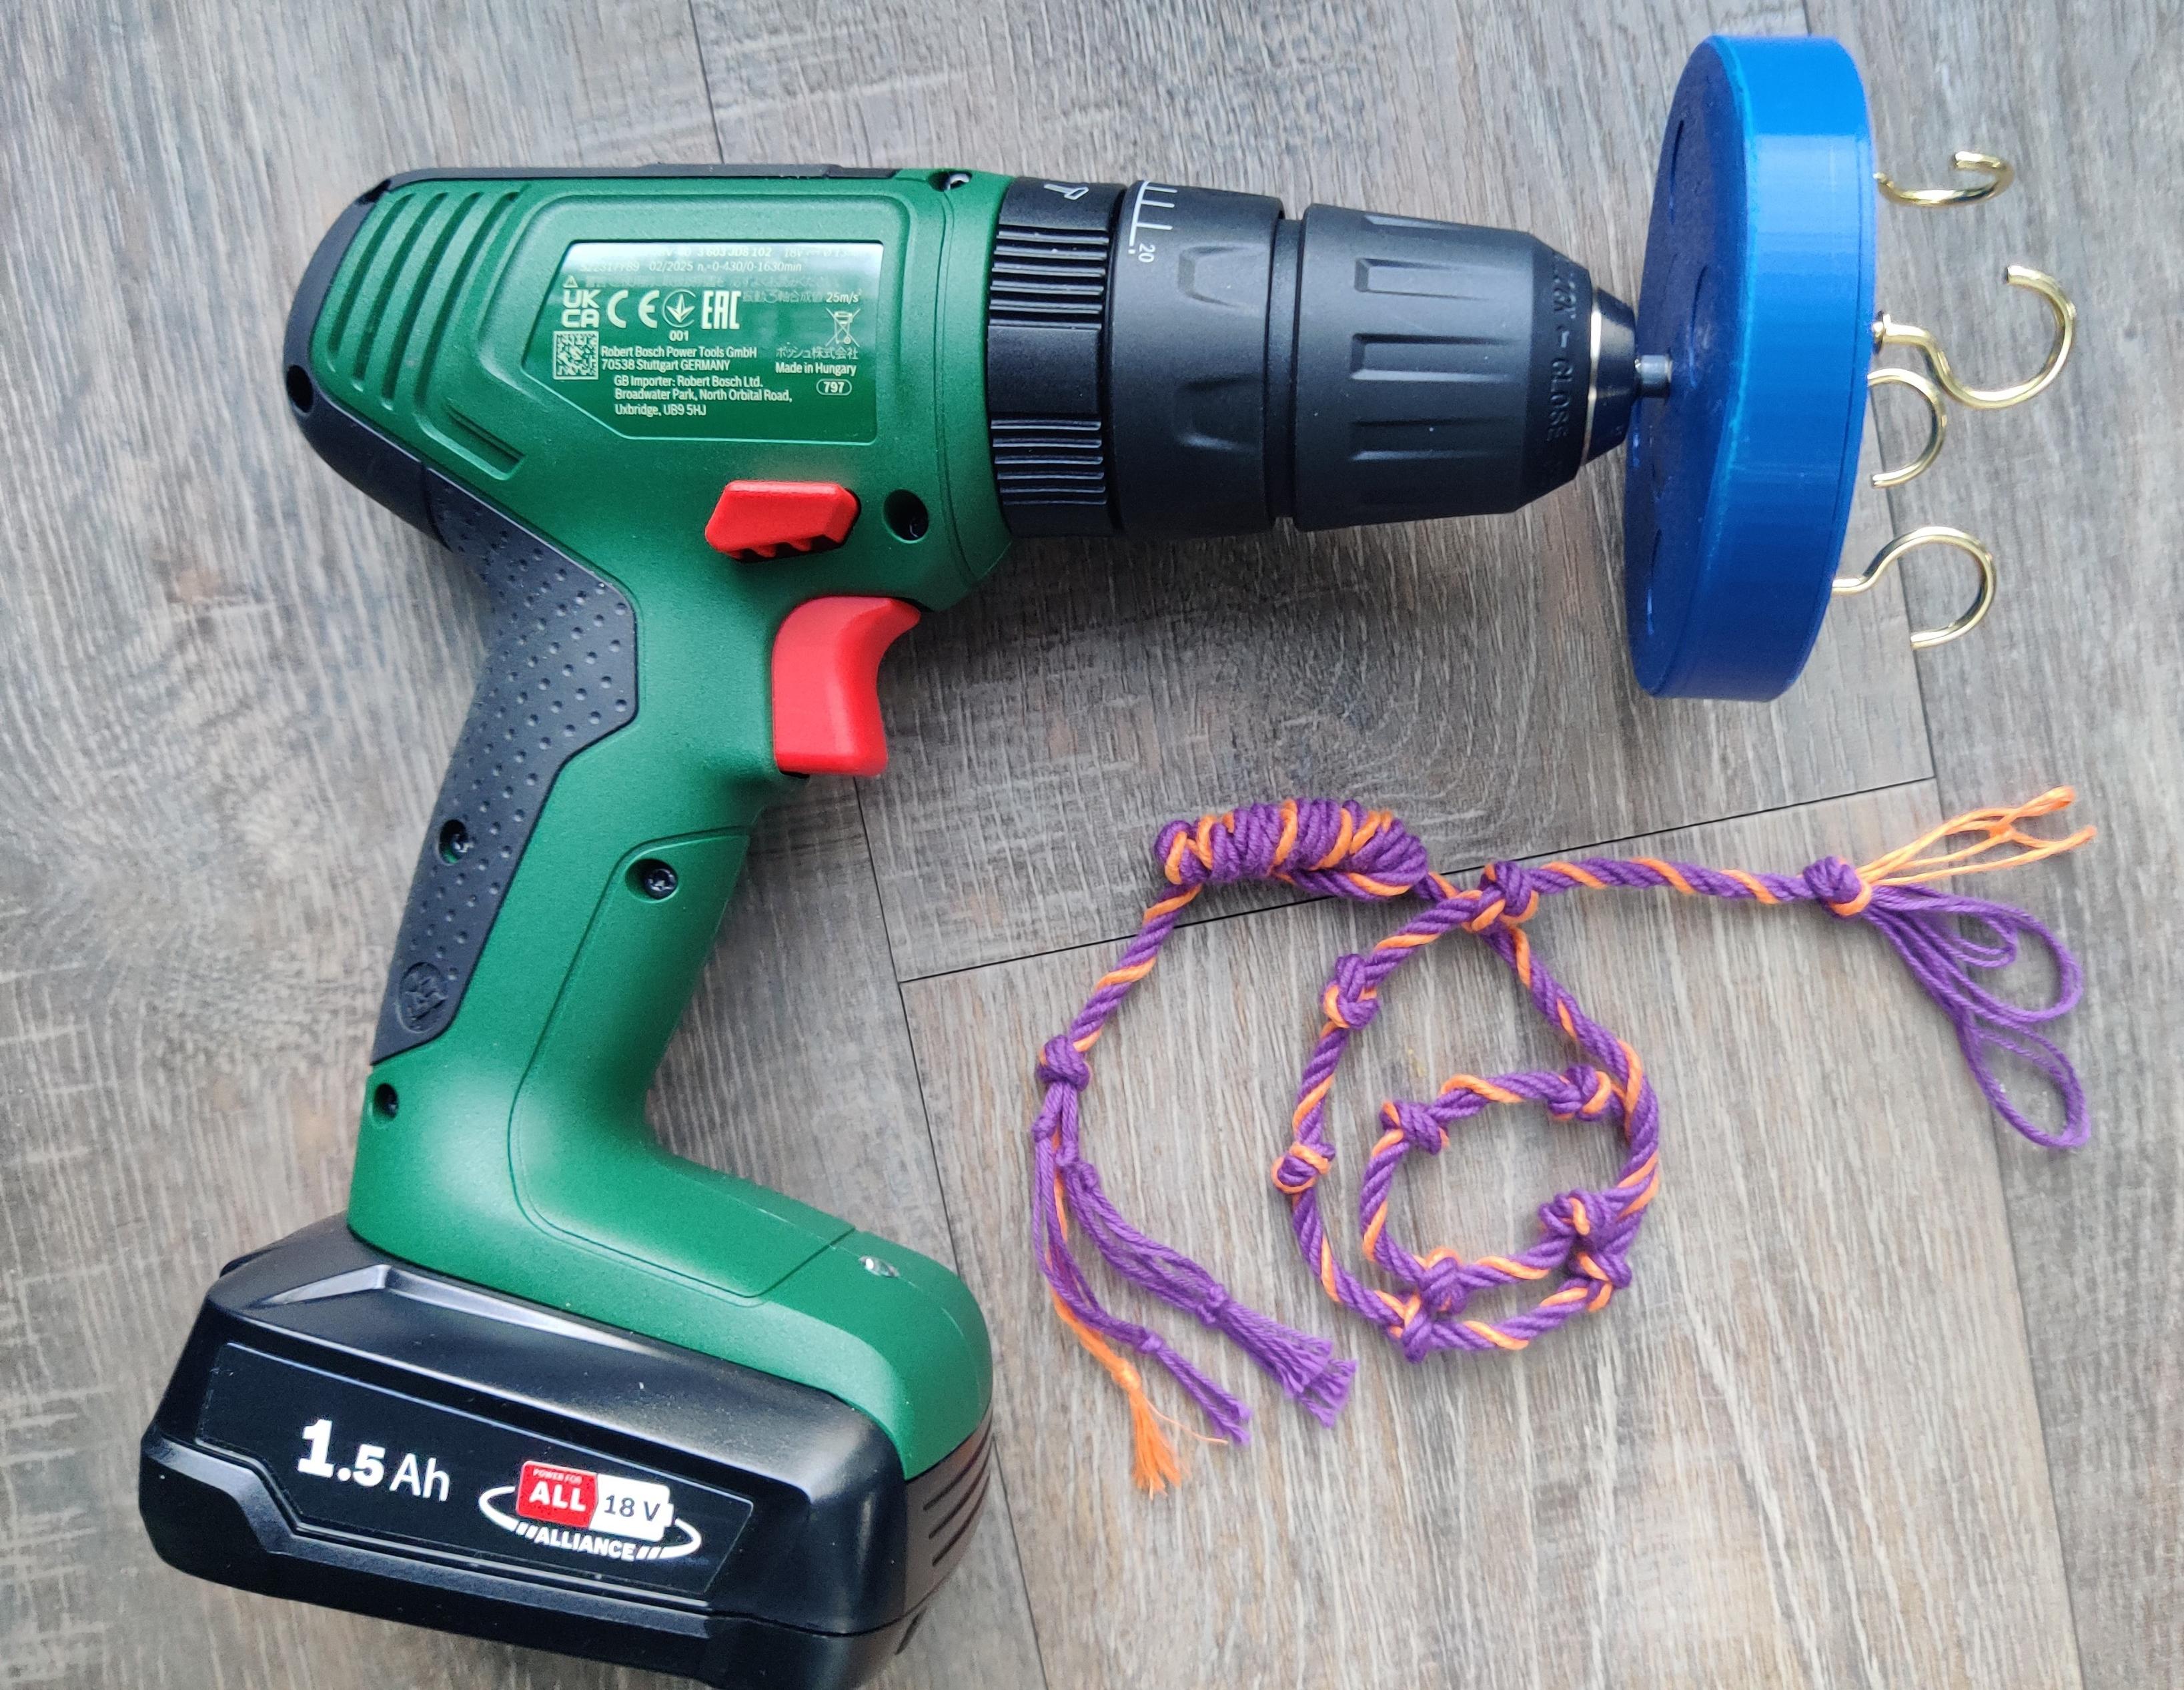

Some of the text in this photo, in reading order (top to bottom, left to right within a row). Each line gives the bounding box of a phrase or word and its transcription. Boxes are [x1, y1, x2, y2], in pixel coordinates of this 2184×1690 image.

[752, 247, 772, 258] 102
[1138, 243, 1156, 263] 20
[649, 261, 693, 273] 02/2025
[562, 290, 600, 308] UK
[607, 289, 660, 328] CE
[562, 309, 600, 328] CA
[668, 330, 689, 342] 001
[601, 346, 757, 358] Robert Bosch Power Tools GmbH
[776, 342, 859, 360] ボッシュ株式会社
[602, 359, 730, 372] 70538 Stuttgart GERMANY
[775, 362, 857, 377] Made in Hungary
[614, 375, 763, 388] GB Importer: Robert Bosch Ltd.
[823, 382, 845, 393] 797
[615, 388, 792, 403] Broadwater Park, North Orbital Road,
[615, 404, 707, 418] Uxbridge, UB9 5HJ
[297, 1418, 450, 1503] 1.5 Ah
[533, 1468, 583, 1485] POWER FOR
[529, 1481, 586, 1512] ALL
[604, 1495, 661, 1522] 18 V
[534, 1526, 637, 1562] ALLIANCE
